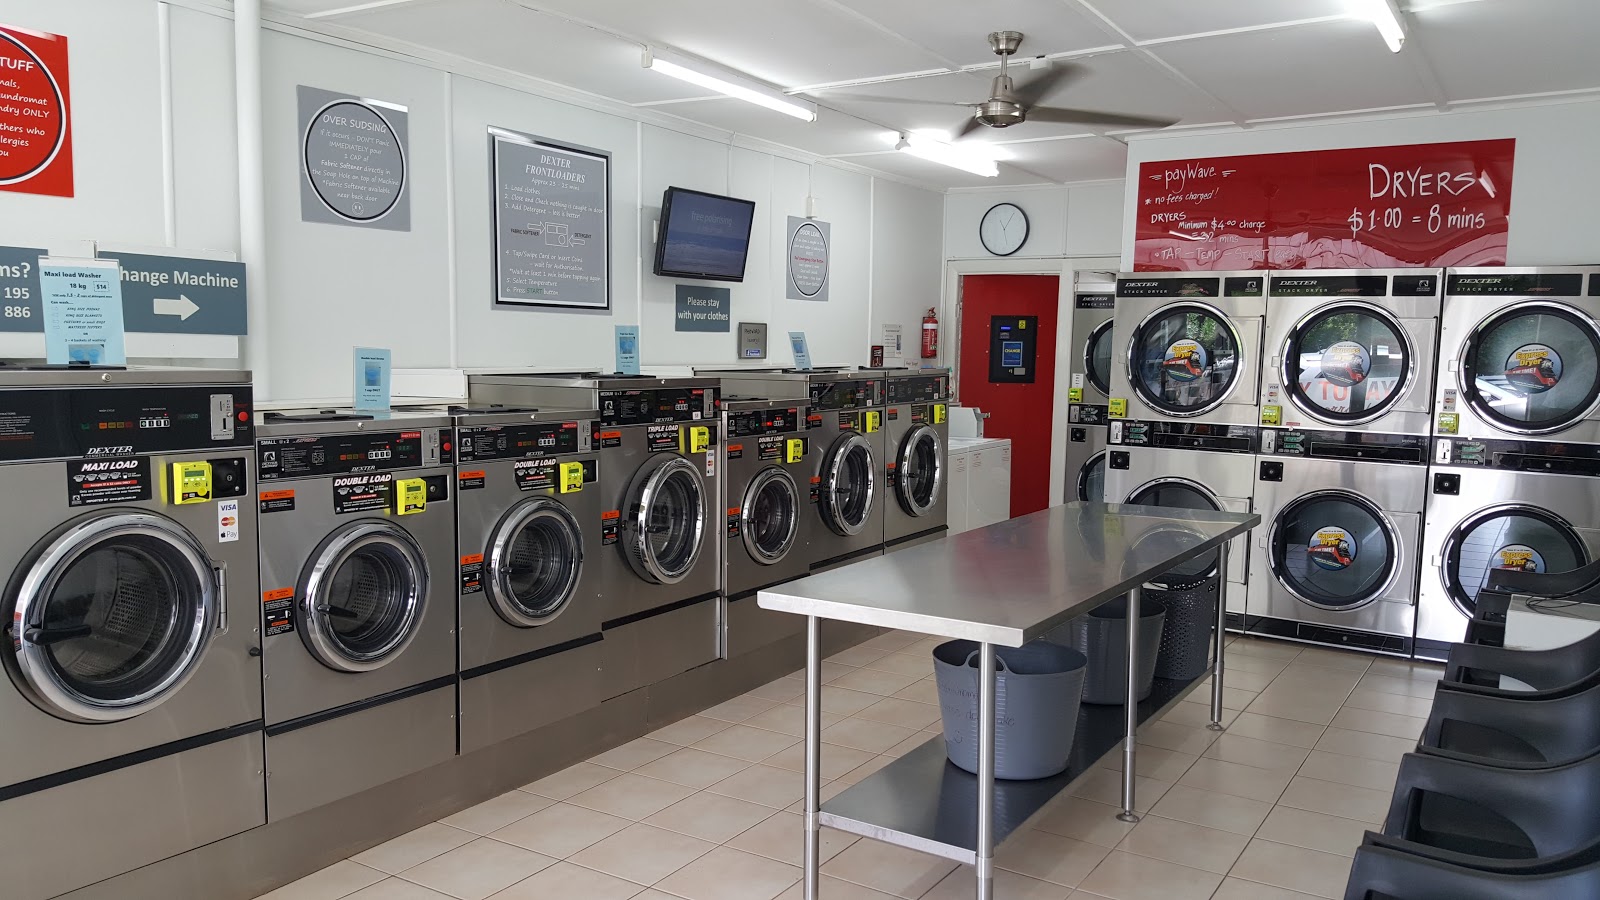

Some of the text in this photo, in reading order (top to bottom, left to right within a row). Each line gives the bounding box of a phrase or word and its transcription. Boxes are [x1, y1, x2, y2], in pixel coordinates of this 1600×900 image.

[23, 108, 50, 118] ONLY
[323, 114, 387, 134] OVER SUDSING
[26, 127, 45, 136] who
[329, 141, 368, 152] IMMEDIATELY
[540, 155, 571, 168] DEXTER
[323, 170, 336, 178] Soap
[340, 162, 362, 171] Softener
[364, 166, 384, 175] directly
[526, 164, 585, 183] FRONTLOADERS
[1165, 162, 1216, 194] payWave
[1368, 163, 1476, 200] DRYERS
[345, 182, 367, 191] Softener
[1166, 194, 1183, 204] fees
[1185, 187, 1219, 204] charged!
[524, 205, 546, 214] Detergent
[1151, 212, 1186, 224] DRYERS
[1427, 204, 1441, 233] 8
[1448, 207, 1485, 229] mins
[1178, 220, 1207, 229] Minimum
[1239, 220, 1266, 233] charge
[1200, 232, 1239, 243] 32 mins
[1162, 248, 1181, 260] TAP
[1195, 247, 1221, 260] TEMP
[120, 266, 239, 288] hange Machine
[528, 279, 557, 287] Temperature
[4, 287, 30, 299] 195
[687, 297, 720, 308] Please stay
[4, 306, 31, 318] 886
[678, 311, 728, 321] with your clothes
[87, 446, 133, 455] DEXTER
[81, 460, 138, 472] MAXI LOAD
[514, 460, 539, 468] DOUBLE
[334, 474, 391, 486] DOUBLE LOAD
[226, 531, 237, 539] Pay
